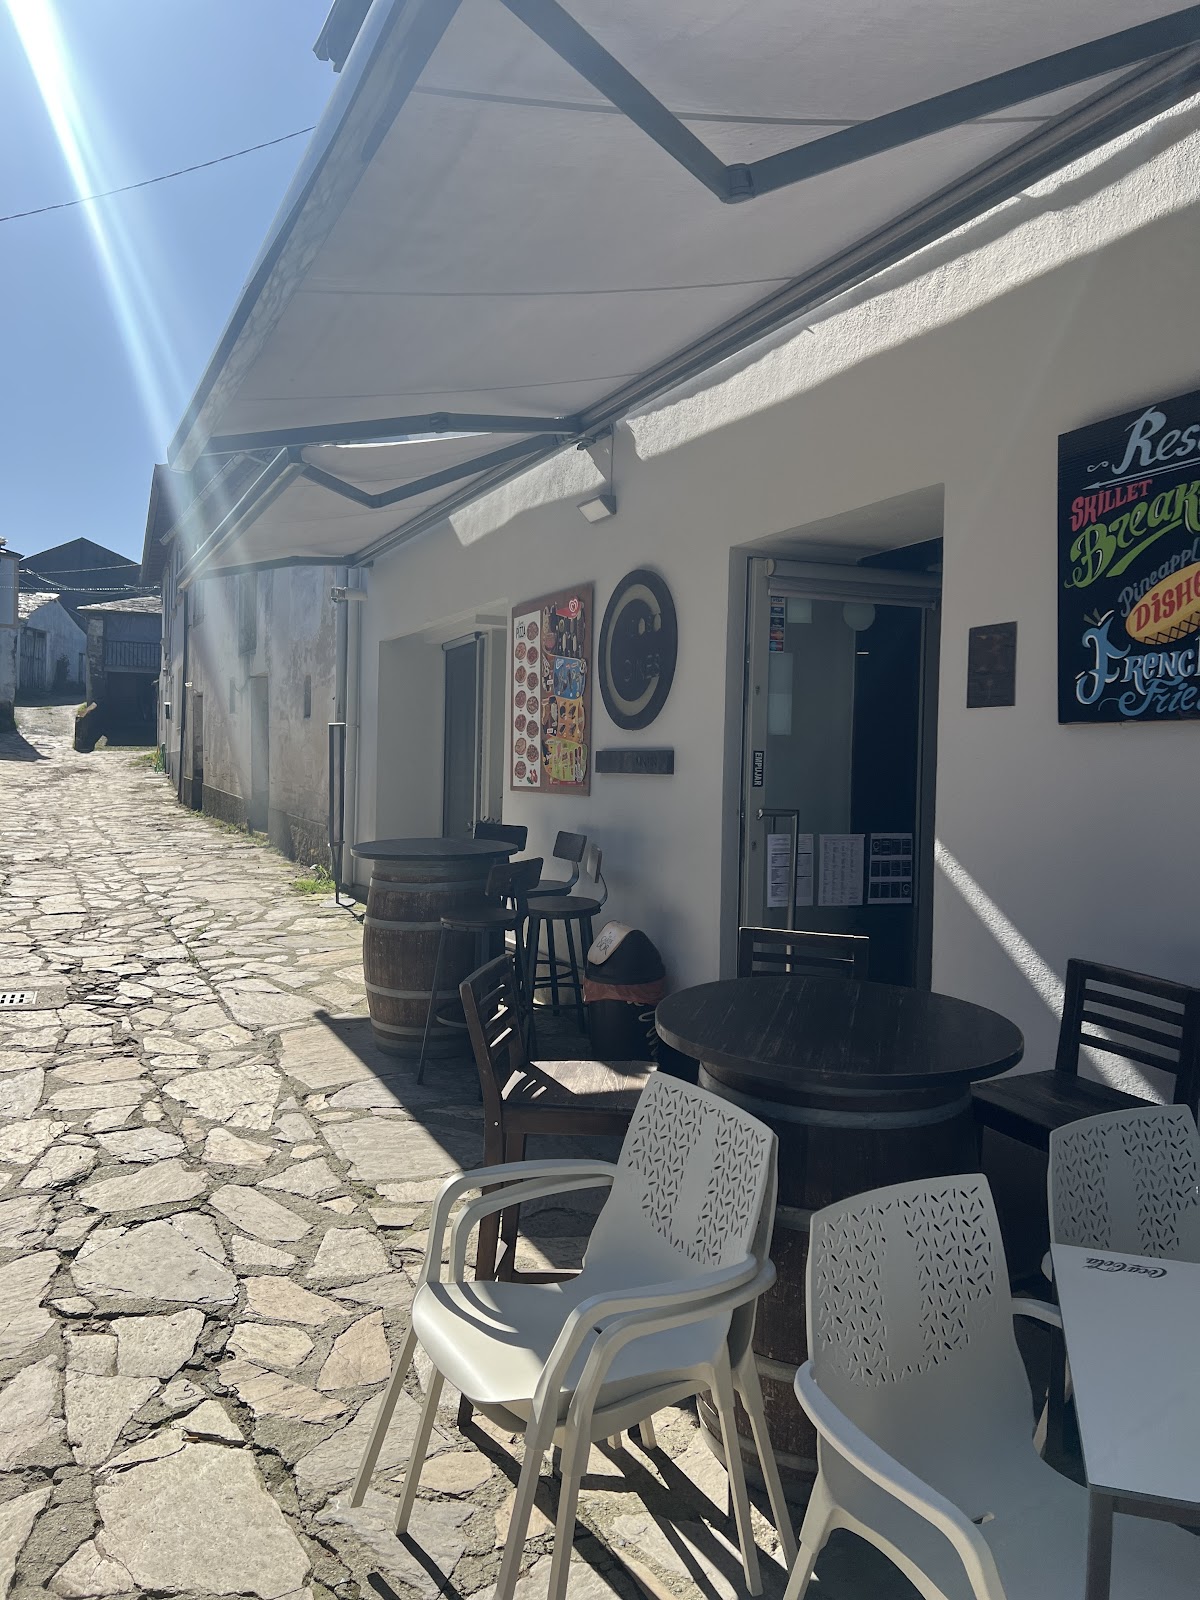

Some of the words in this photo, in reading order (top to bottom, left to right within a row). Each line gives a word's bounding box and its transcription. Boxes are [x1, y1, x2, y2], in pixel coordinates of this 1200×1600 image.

[1112, 405, 1200, 474] Res
[1064, 480, 1200, 588] Break
[1075, 610, 1200, 705] FRENC
[1099, 676, 1200, 717] Frie
[753, 752, 763, 786] EMPUJAR
[1082, 1257, 1167, 1278] Coca-Cola
